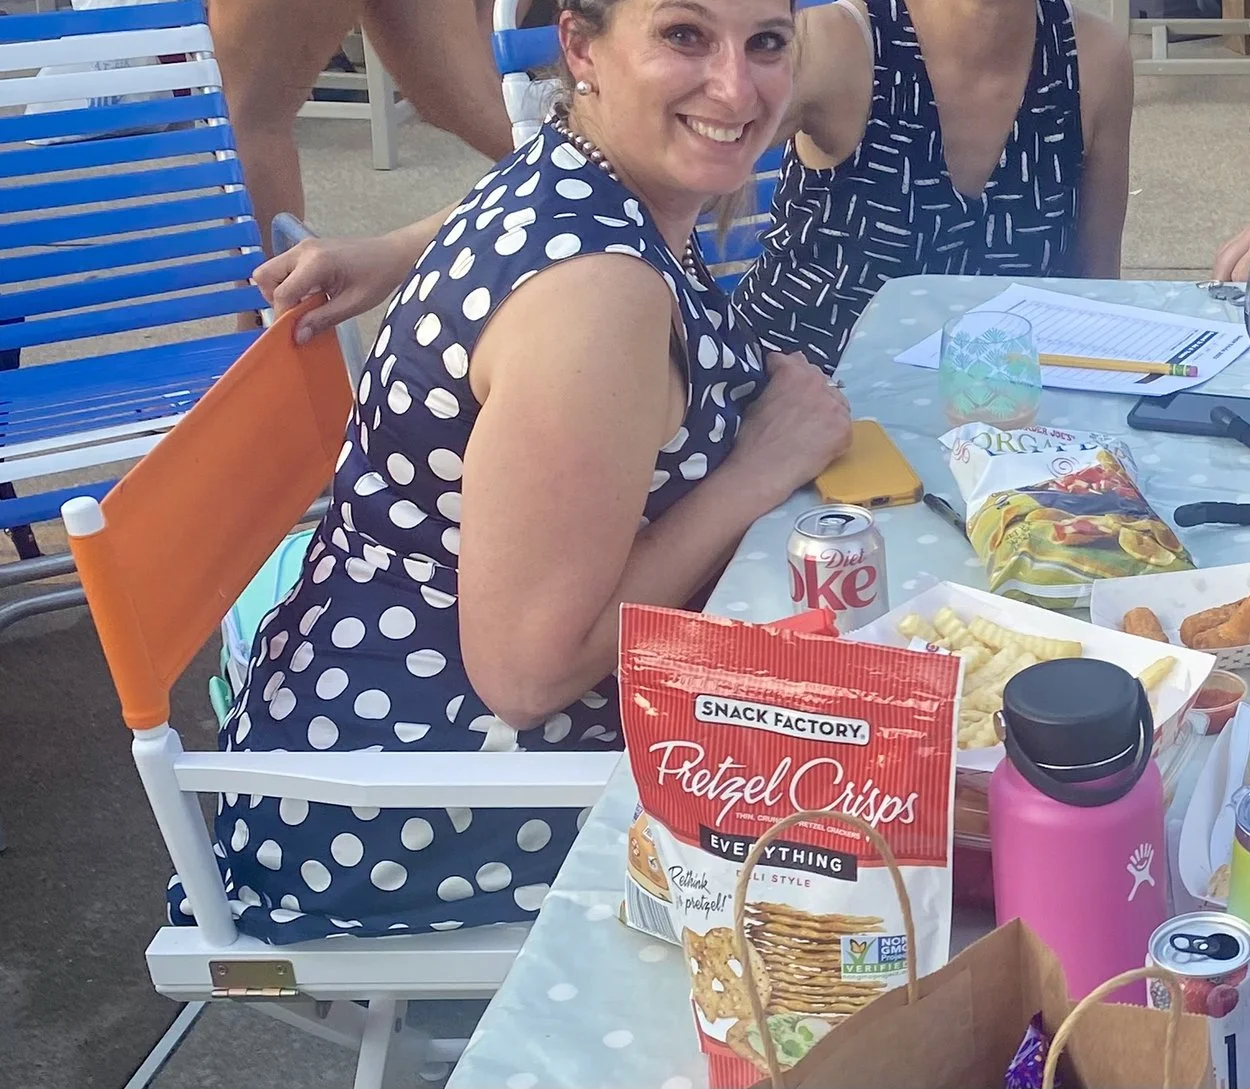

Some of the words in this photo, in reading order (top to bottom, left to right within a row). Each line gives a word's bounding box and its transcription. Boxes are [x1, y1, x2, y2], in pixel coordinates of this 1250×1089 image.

[820, 548, 865, 568] Diet
[787, 553, 878, 611] oke
[701, 701, 769, 725] SNACK
[774, 712, 862, 739] FACTORY
[649, 740, 792, 827] Pretzel
[789, 757, 919, 842] Crisps
[668, 865, 711, 895] Rethink
[771, 874, 812, 888] STYLE
[684, 892, 728, 920] pretzel!
